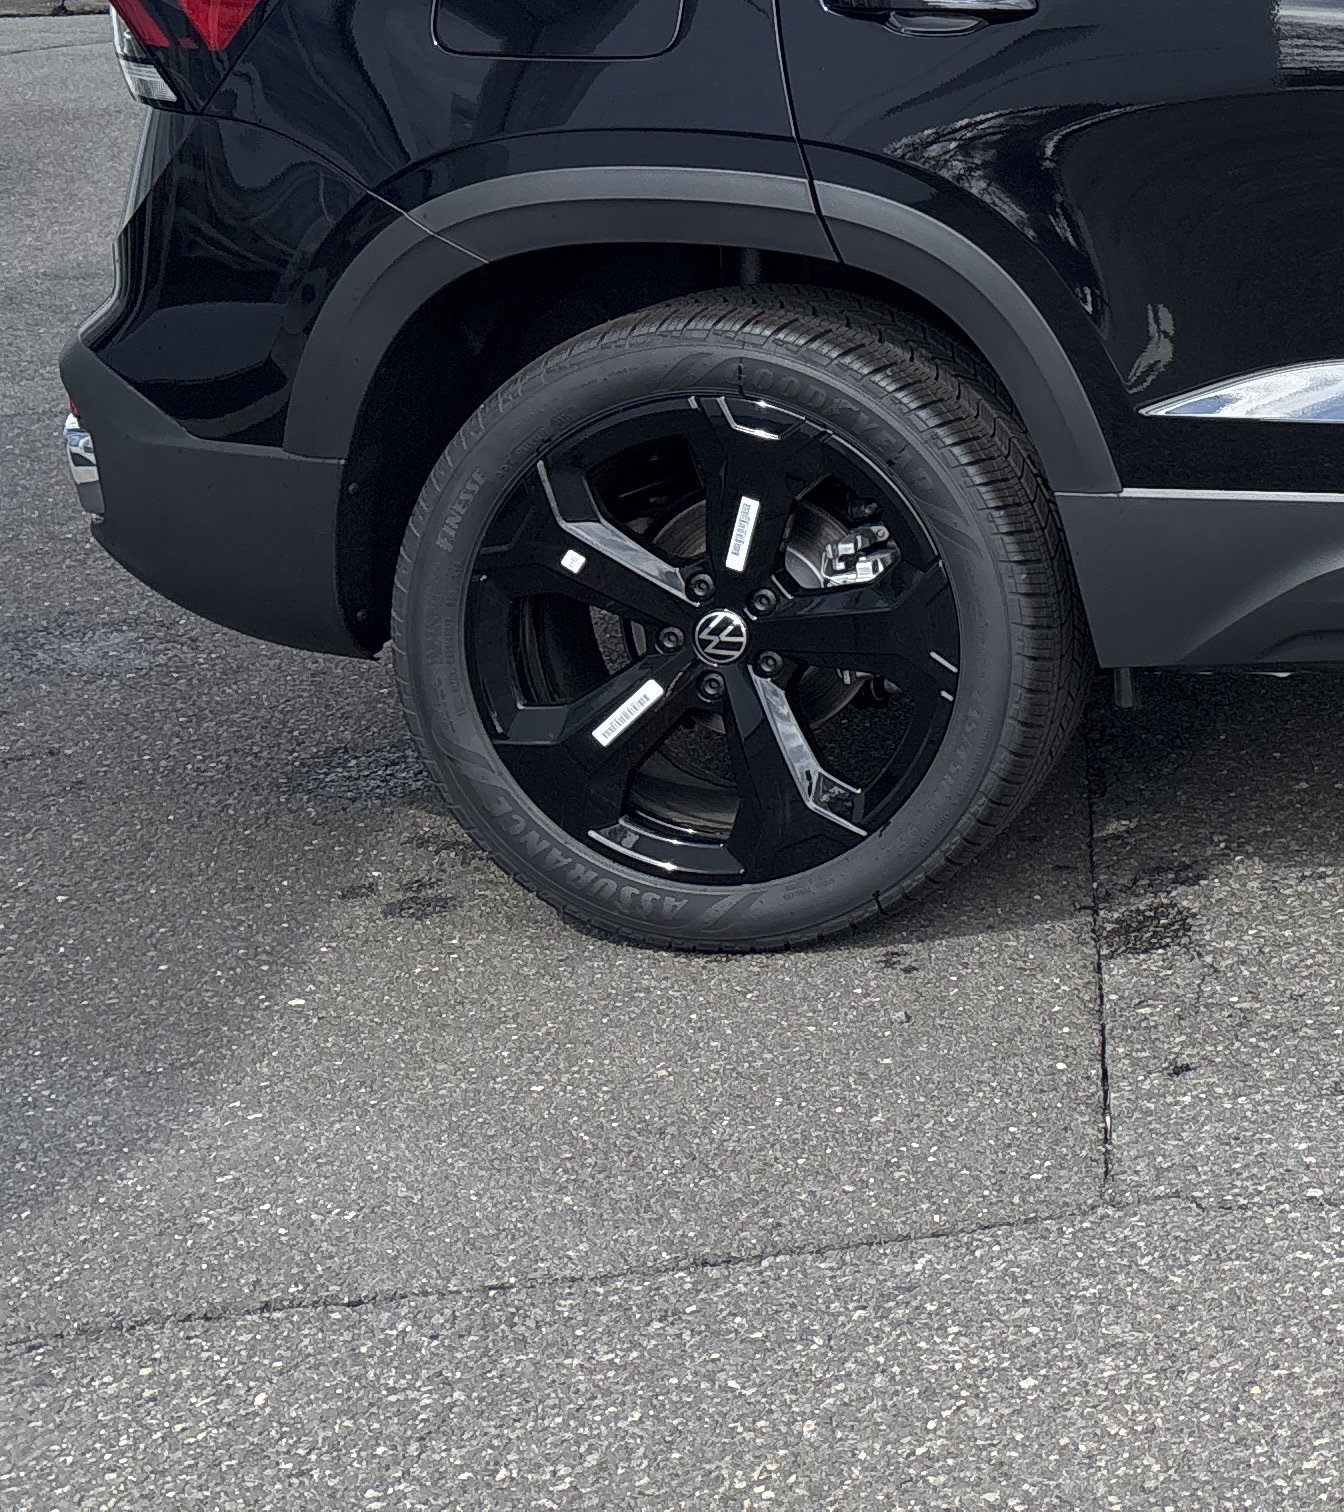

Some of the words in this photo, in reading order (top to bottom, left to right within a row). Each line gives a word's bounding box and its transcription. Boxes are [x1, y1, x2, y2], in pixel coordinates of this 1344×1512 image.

[723, 365, 938, 499] GOODYEAR
[435, 465, 488, 554] FINESSE
[482, 792, 688, 921] ASSURANCE
